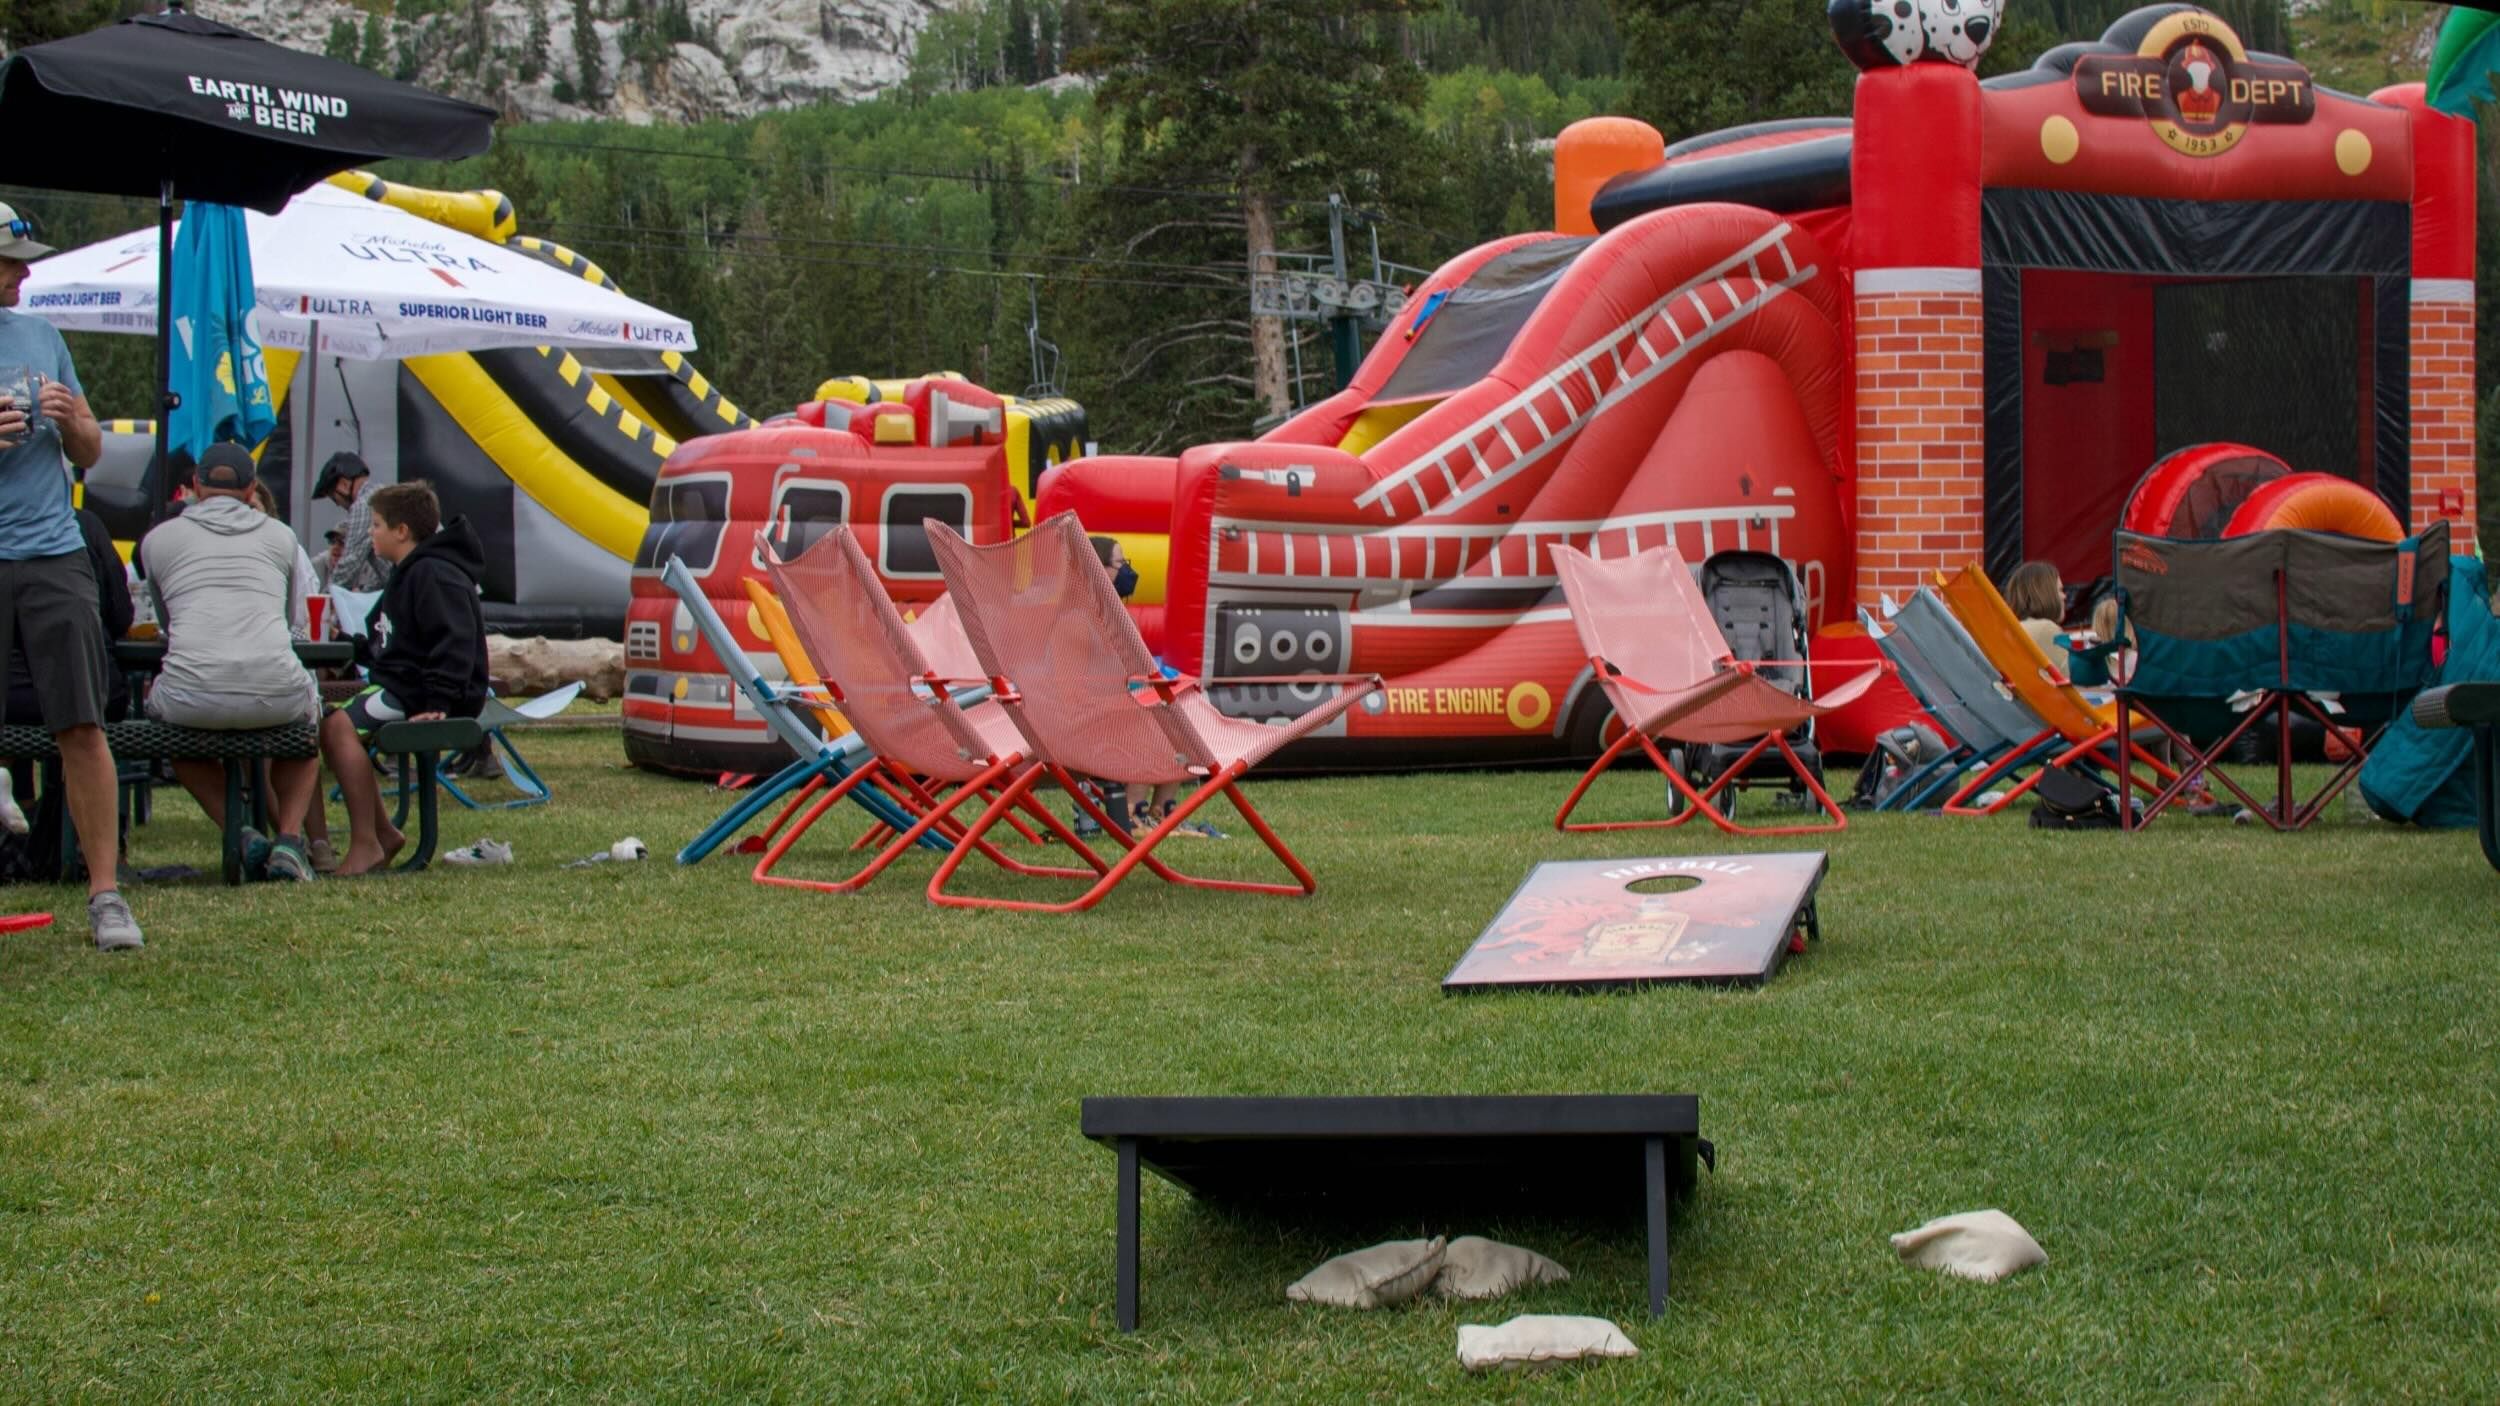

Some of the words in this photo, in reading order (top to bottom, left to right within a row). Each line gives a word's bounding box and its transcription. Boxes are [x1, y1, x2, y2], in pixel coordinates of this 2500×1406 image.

[2102, 71, 2161, 98] FIRE
[2231, 79, 2303, 105] DEPT
[278, 88, 348, 118] WIND
[254, 104, 316, 136] BEER
[2185, 137, 2217, 152] 1953
[340, 242, 502, 274] ULTRA
[29, 294, 72, 307] SUPERIOR
[73, 292, 99, 305] LIGHT
[100, 291, 121, 305] BEER
[312, 299, 374, 315] ULTRA
[399, 303, 469, 320] SUPERIOR
[472, 308, 512, 325] LIGHT
[515, 312, 547, 328] BEER
[633, 327, 686, 344] ULTRA
[1388, 688, 1430, 714] FIRE
[1435, 688, 1504, 714] ENGINE
[1601, 861, 1752, 880] FIREBALL
